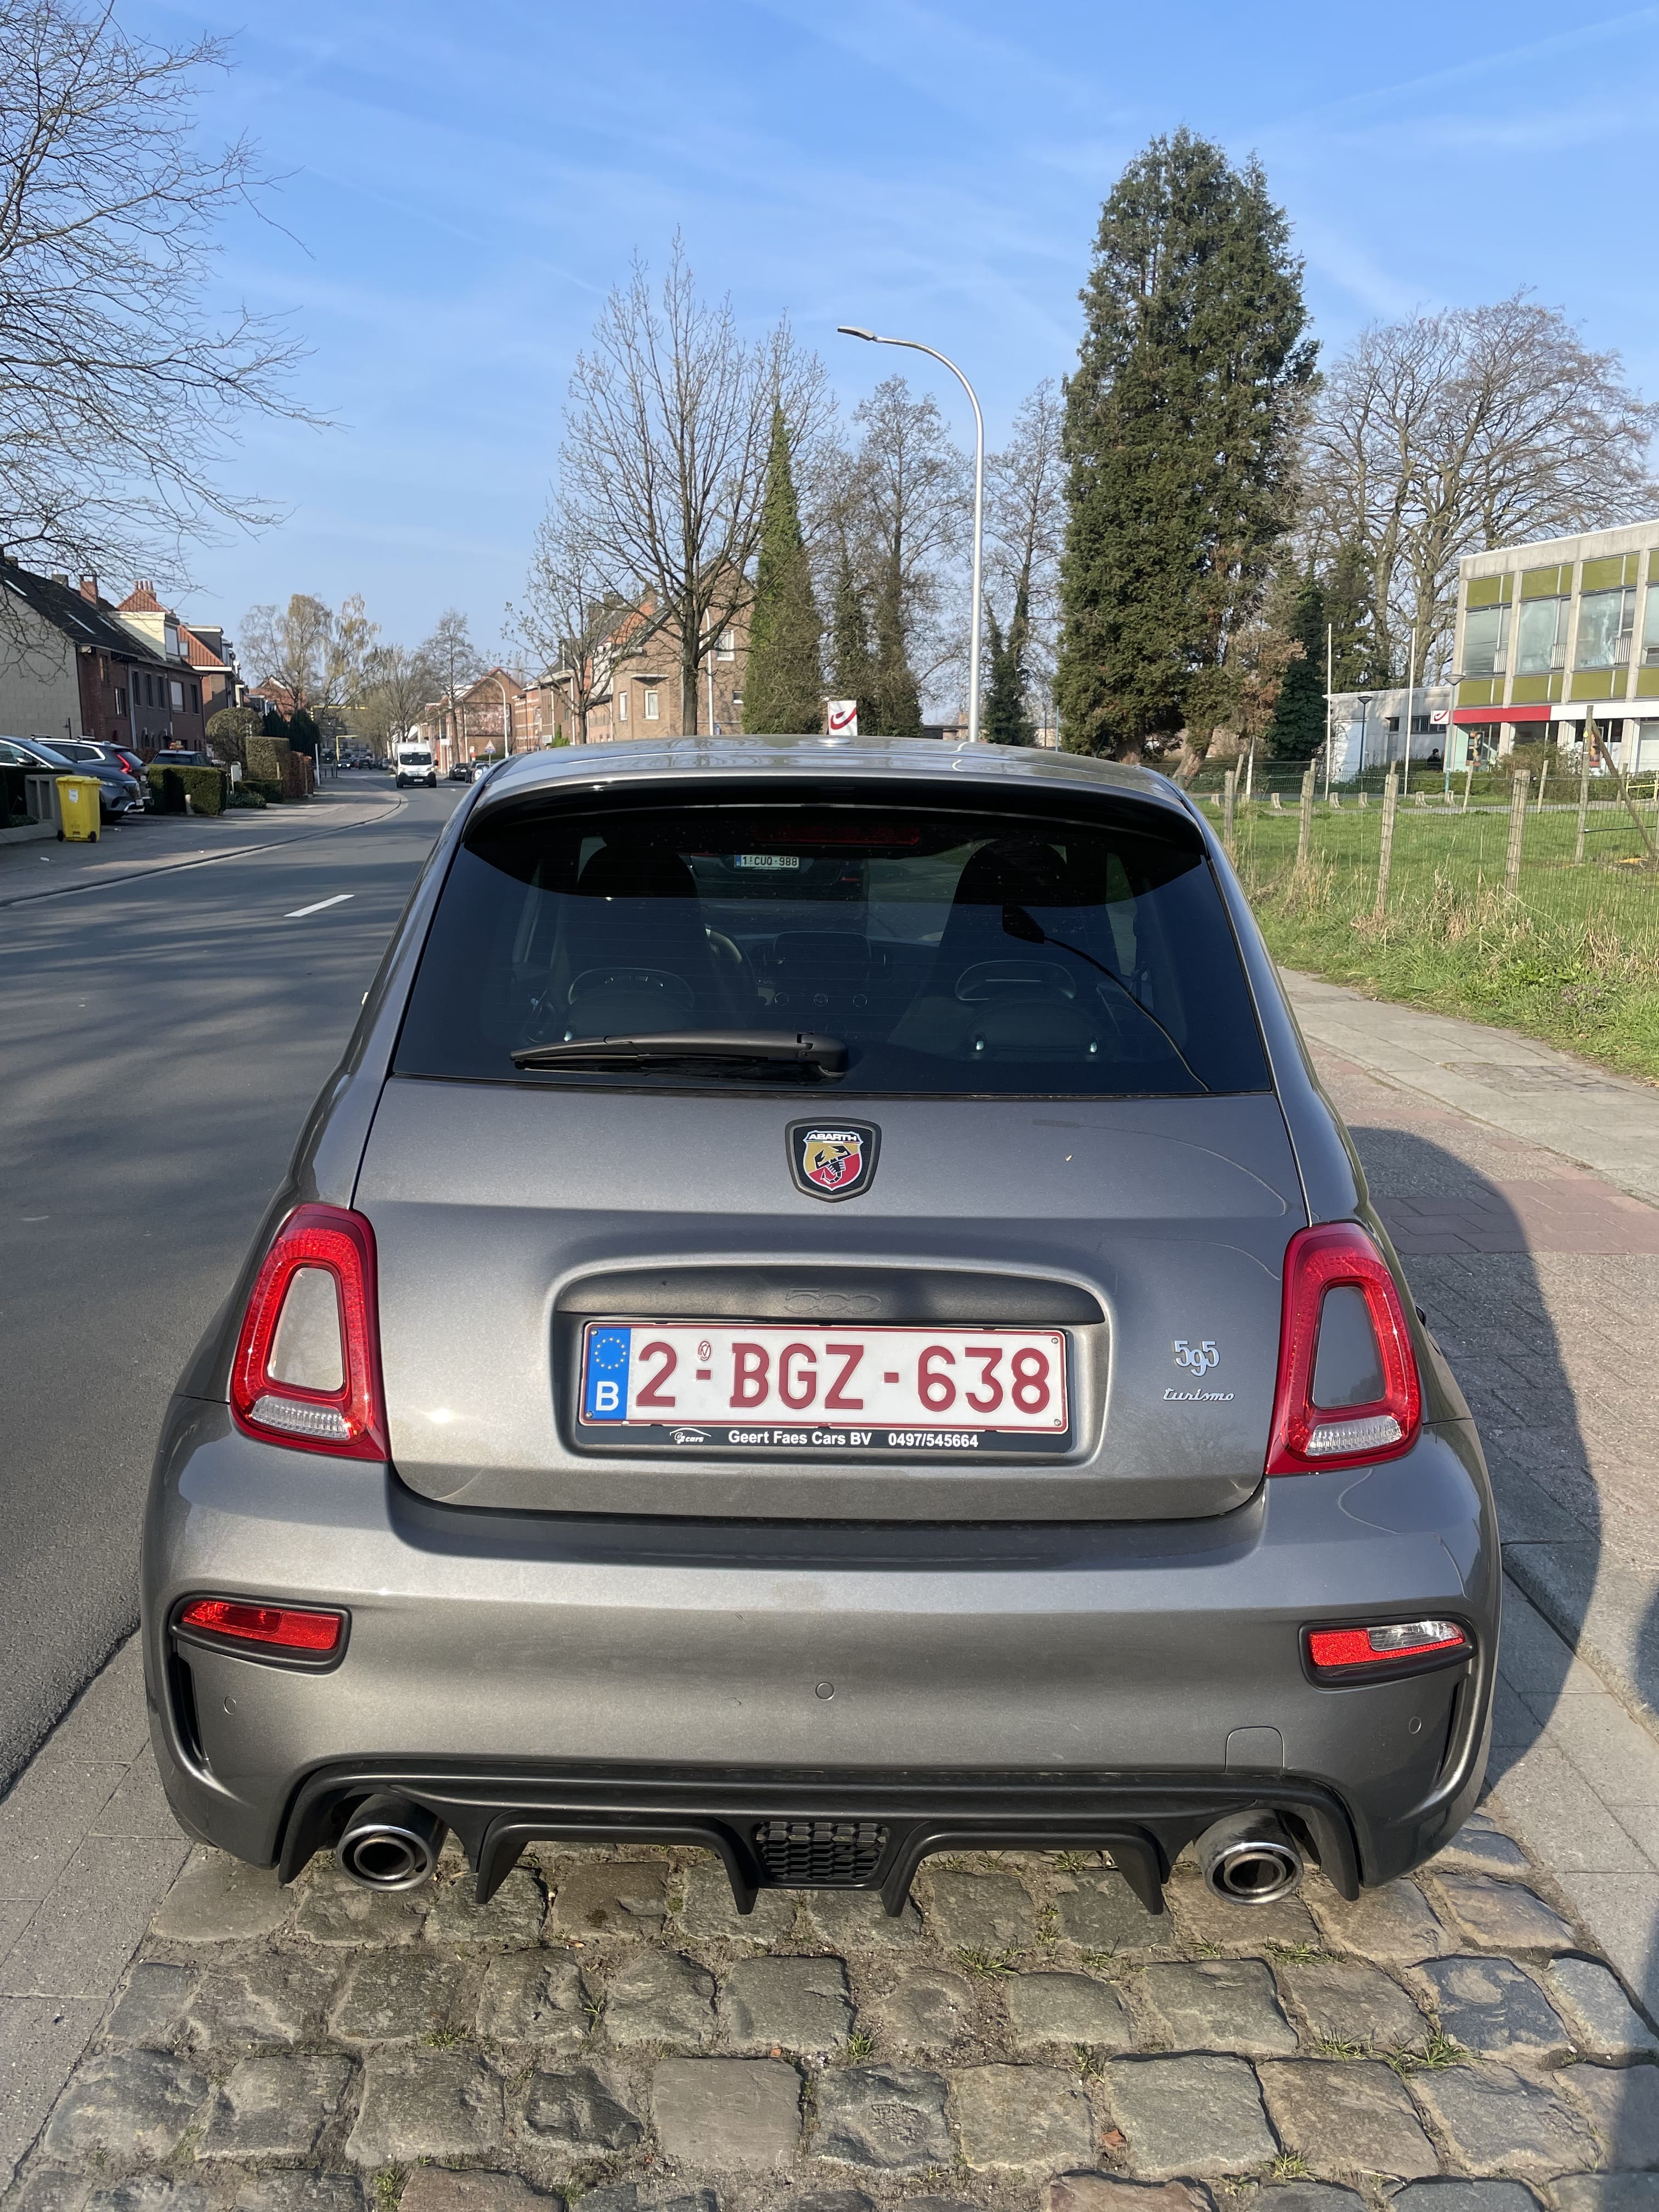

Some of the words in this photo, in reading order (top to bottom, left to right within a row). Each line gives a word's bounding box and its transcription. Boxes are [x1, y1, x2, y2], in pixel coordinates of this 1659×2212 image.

[1174, 1340, 1220, 1376] 595
[635, 1341, 1050, 1414] 2-BGZ-638
[595, 1381, 619, 1412] B
[1163, 1388, 1234, 1401] turismo
[729, 1430, 769, 1443] Geert
[774, 1431, 808, 1444] Faes
[811, 1431, 845, 1444] Cars
[850, 1432, 872, 1445] BV
[888, 1433, 978, 1447] 0497/545664
